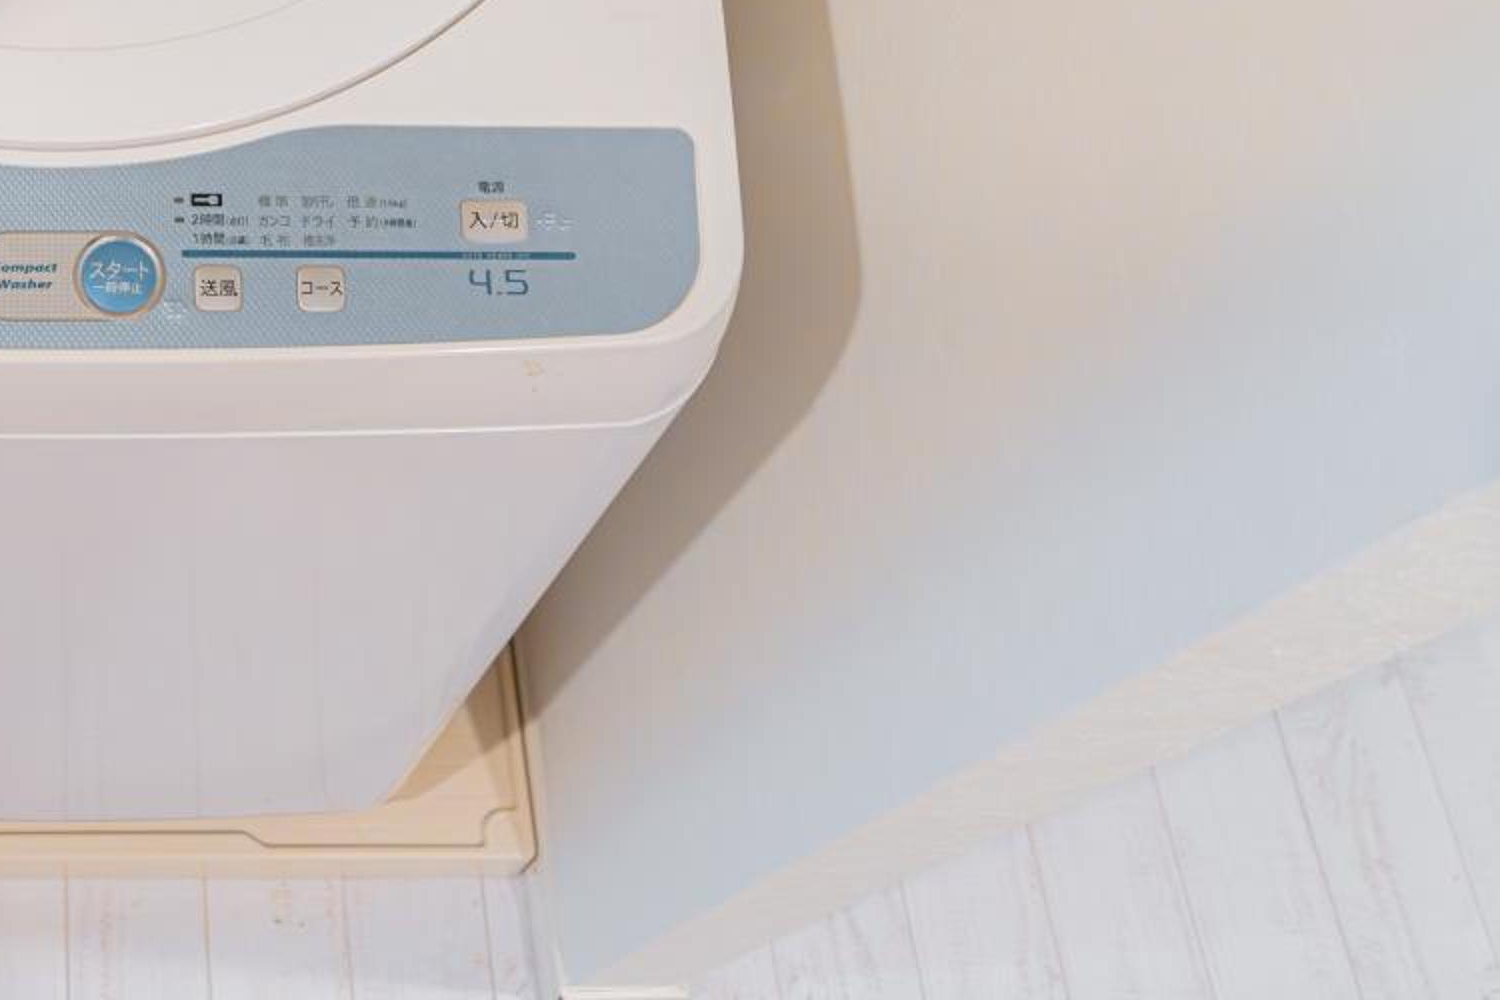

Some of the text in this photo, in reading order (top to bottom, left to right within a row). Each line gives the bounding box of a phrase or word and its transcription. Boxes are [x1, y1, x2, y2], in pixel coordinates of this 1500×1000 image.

[469, 211, 520, 229] 入/切
[89, 260, 149, 281] スタート
[200, 278, 239, 297] 送風
[301, 280, 343, 296] コース
[469, 269, 529, 295] 4.5
